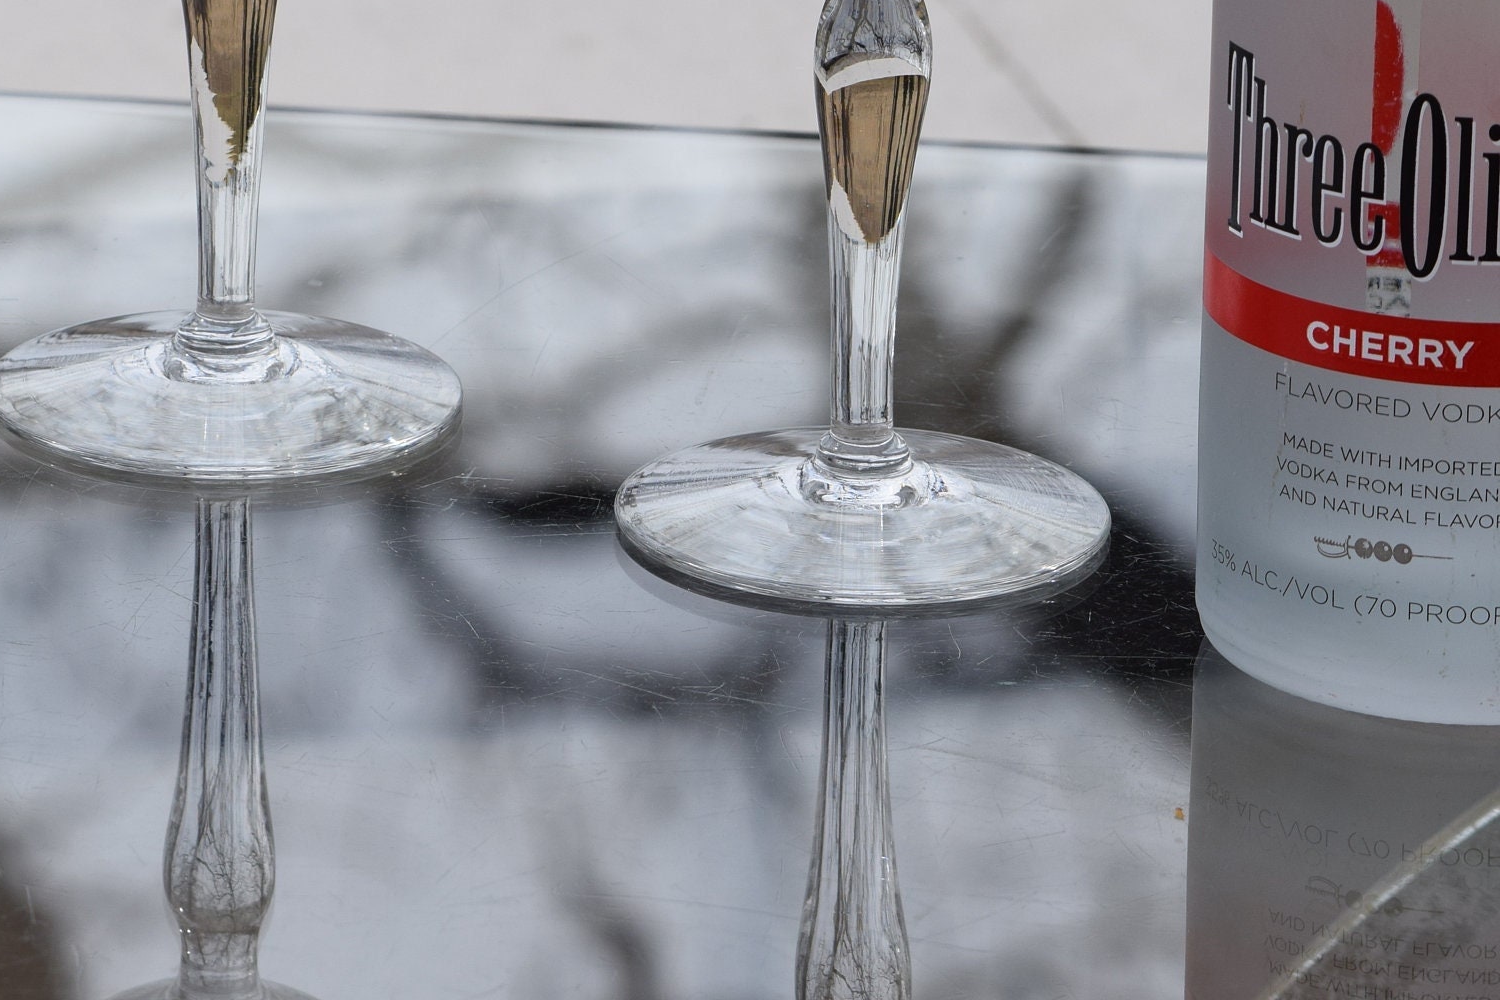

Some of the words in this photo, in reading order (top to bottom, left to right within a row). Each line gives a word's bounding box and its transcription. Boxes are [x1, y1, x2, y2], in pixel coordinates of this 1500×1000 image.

[1227, 40, 1387, 256] Three
[1306, 321, 1475, 369] CHERRY
[1275, 372, 1411, 418] FLAVORED
[1283, 432, 1334, 459] MADE
[1341, 446, 1392, 468] WITH
[1276, 456, 1339, 486] VODKA
[1346, 474, 1402, 497] FROM
[1411, 483, 1499, 502] ENGLAN
[1279, 484, 1316, 506] AND
[1323, 496, 1417, 525] NATURAL
[1424, 511, 1500, 529] FLAVO
[1211, 538, 1236, 571] 35%
[1241, 560, 1344, 610] ALC./VOL
[1354, 595, 1396, 618] (70
